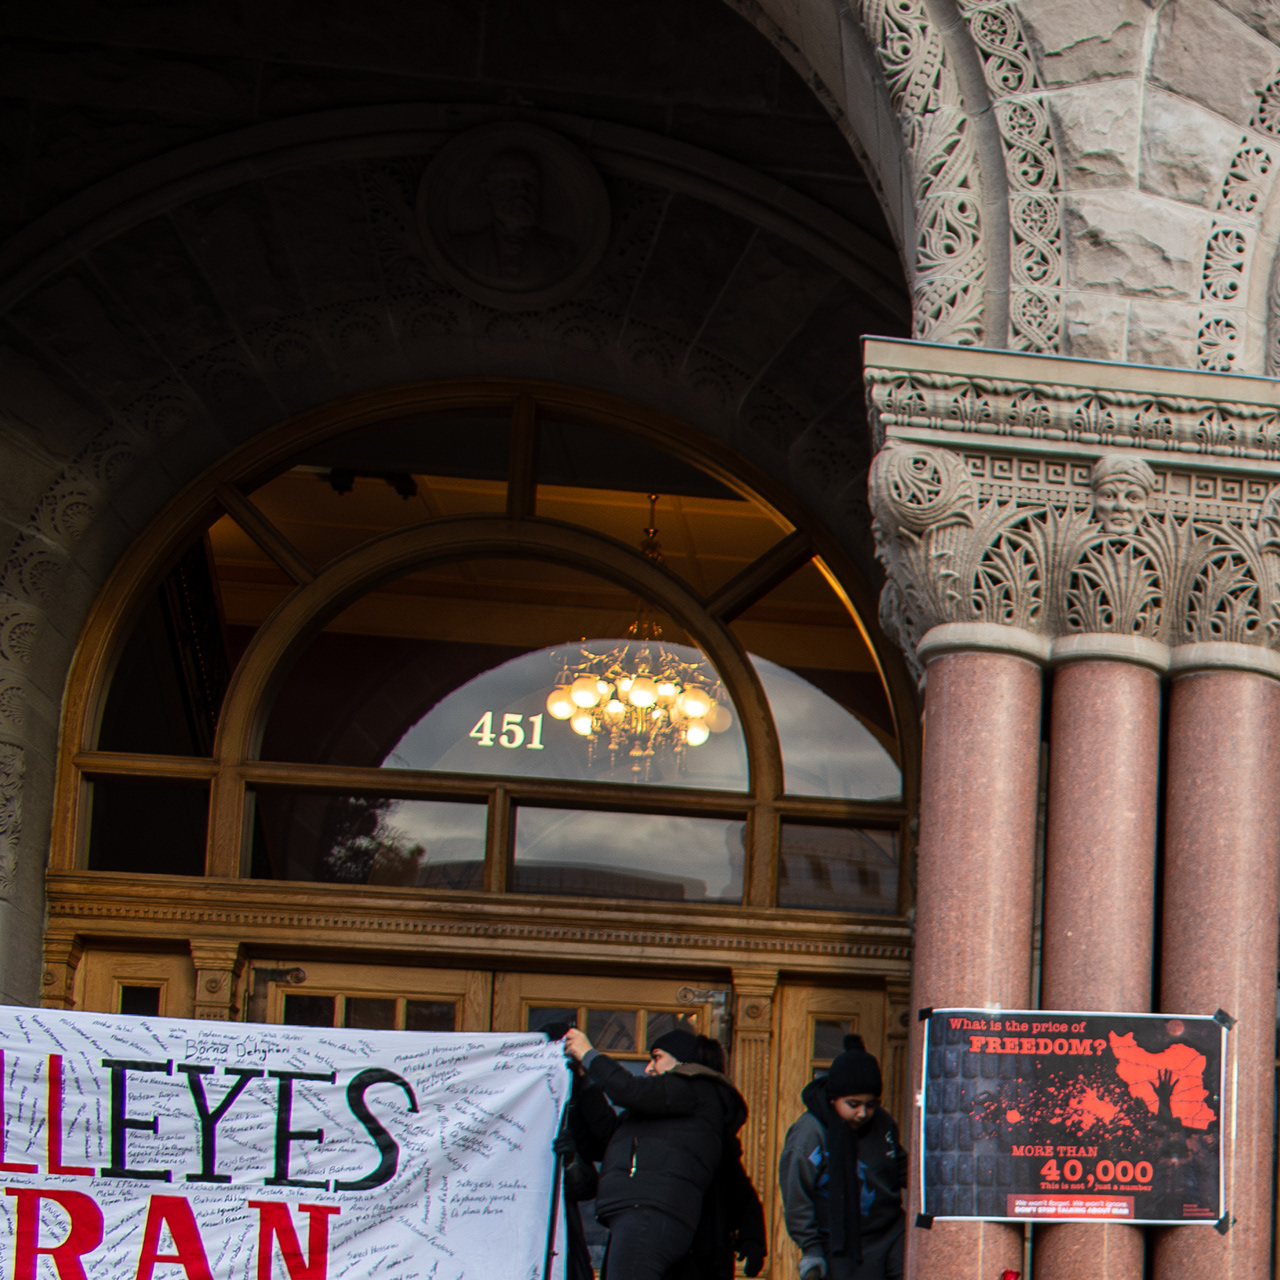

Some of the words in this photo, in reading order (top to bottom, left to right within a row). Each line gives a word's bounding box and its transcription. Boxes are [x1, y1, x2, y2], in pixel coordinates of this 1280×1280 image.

[469, 711, 545, 750] 451
[949, 1018, 987, 1031] What
[990, 1020, 1001, 1031] is
[1005, 1020, 1029, 1032] the
[1032, 1021, 1068, 1034] price
[1071, 1021, 1087, 1033] of
[969, 1035, 1107, 1056] FREEDOM?
[1011, 1145, 1054, 1157] MORE
[1057, 1146, 1098, 1158] THAN
[1040, 1158, 1153, 1188] 40,000
[1040, 1181, 1059, 1190] This
[1061, 1181, 1069, 1190] is
[1070, 1182, 1085, 1190] not
[1094, 1183, 1111, 1192] just
[1120, 1184, 1152, 1192] number
